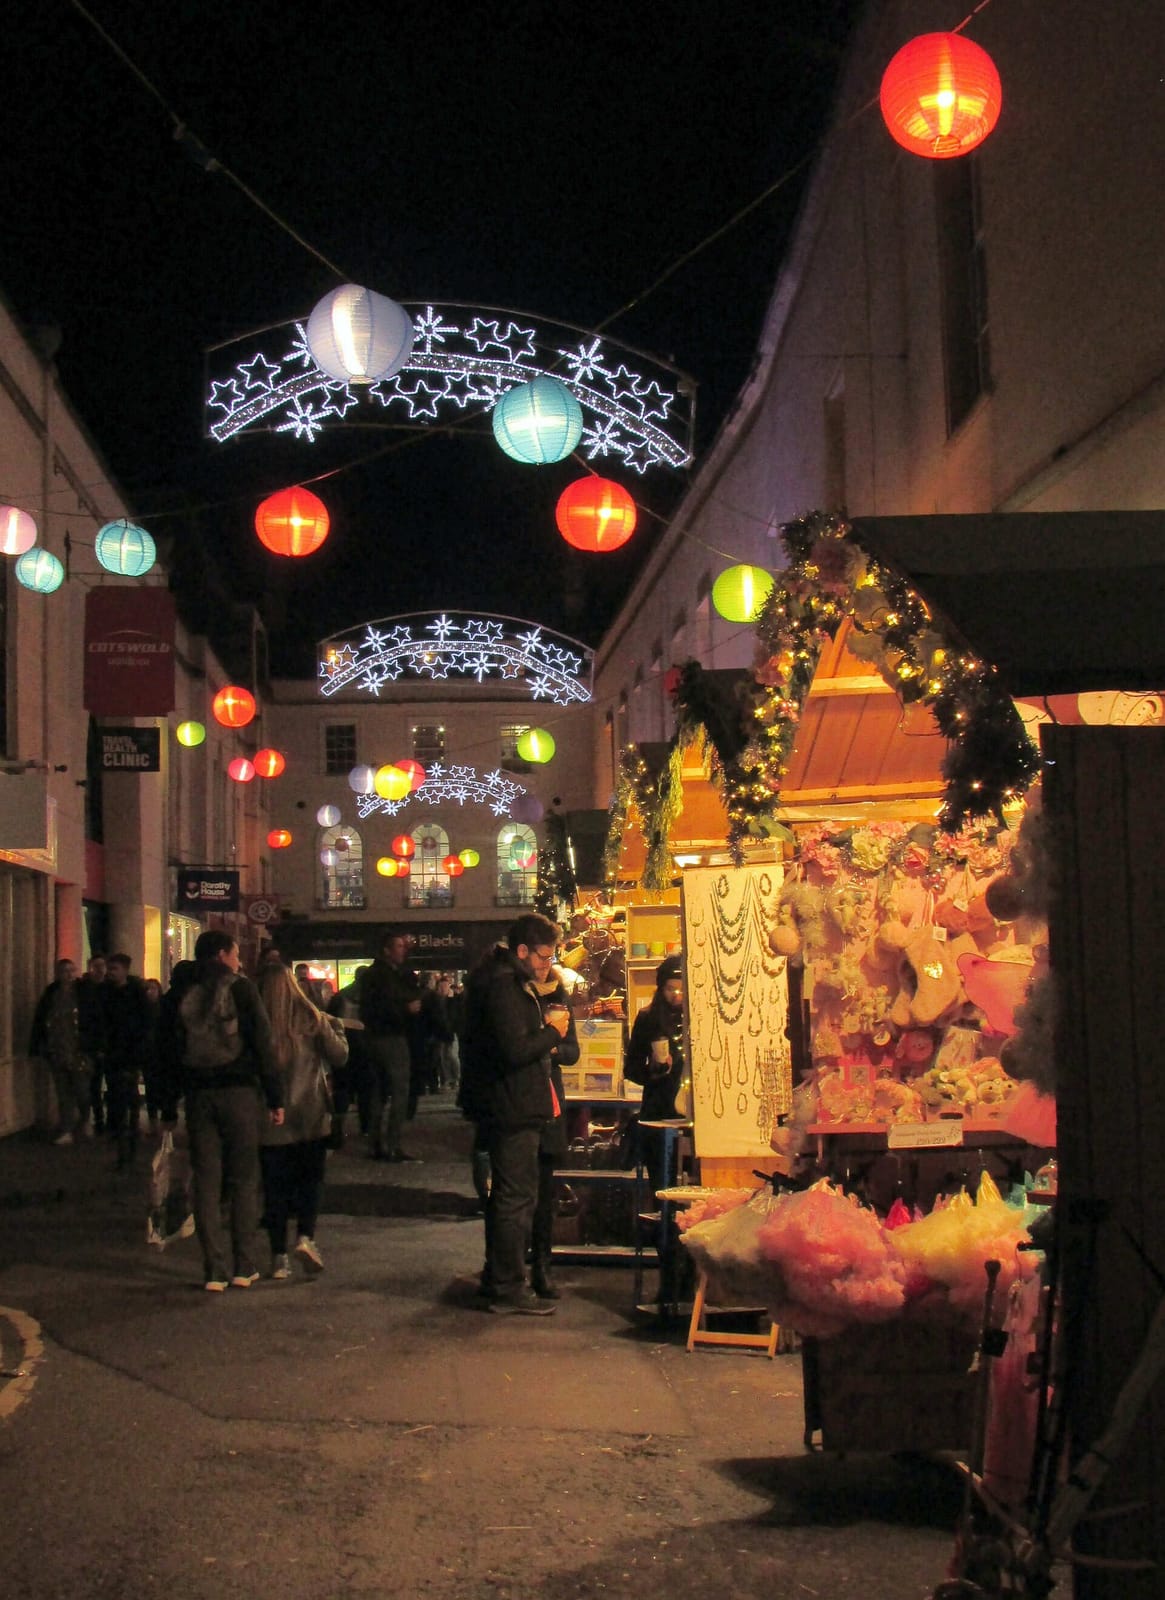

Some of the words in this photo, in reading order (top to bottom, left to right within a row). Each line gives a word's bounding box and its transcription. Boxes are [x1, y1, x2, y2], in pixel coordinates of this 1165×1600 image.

[88, 642, 170, 653] COTSWOLD
[103, 753, 150, 767] CLINIC
[200, 881, 231, 890] Dorothy
[200, 887, 225, 895] House
[418, 934, 464, 947] Blacks
